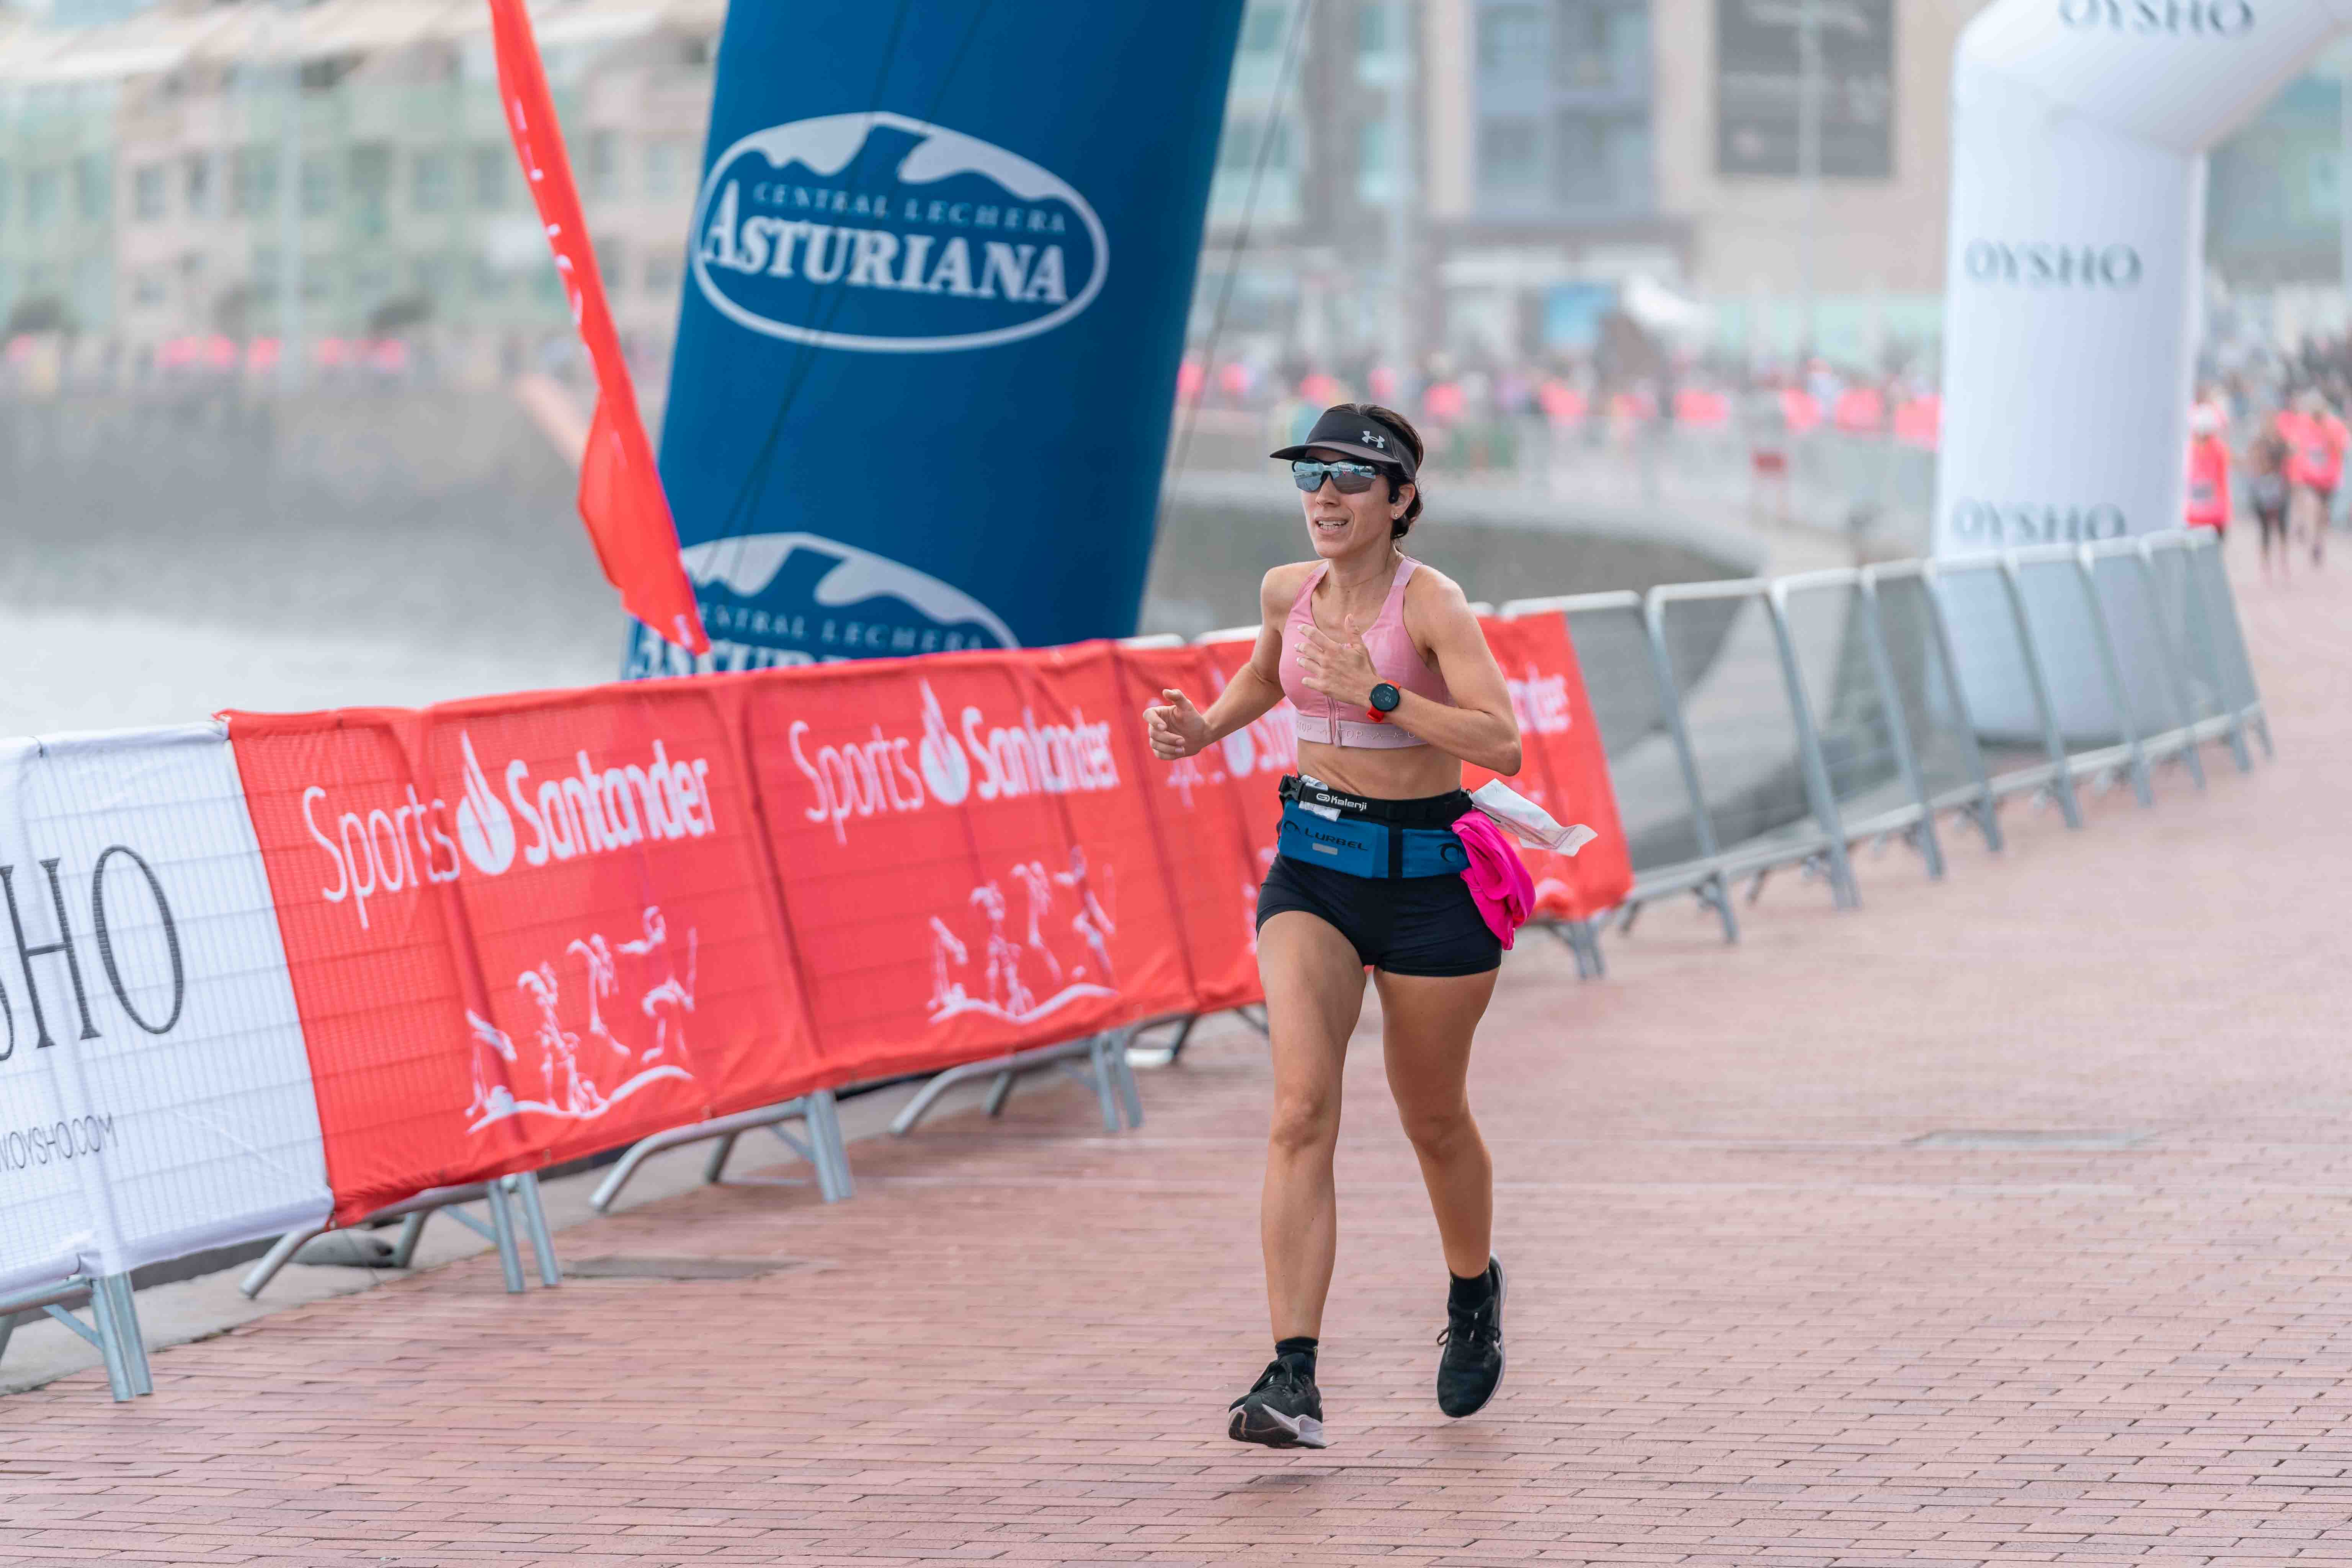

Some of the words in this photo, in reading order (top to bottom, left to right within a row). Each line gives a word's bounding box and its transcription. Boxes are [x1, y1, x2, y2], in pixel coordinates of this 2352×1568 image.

[2060, 0, 2254, 36] OYSHO
[753, 181, 889, 219] CENTRAL
[904, 197, 1067, 236] LECHERA
[700, 178, 1070, 305] ASTURIANA
[1964, 238, 2142, 289] OYSHO
[1952, 497, 2127, 546] OYSHO
[820, 617, 983, 652] LECHERA
[789, 720, 925, 846] Sports
[961, 705, 1121, 800] Santander
[1331, 795, 1367, 811] Kalenji
[302, 785, 461, 930] Sports
[505, 739, 716, 866] Santander
[1305, 827, 1368, 851] LURBEL
